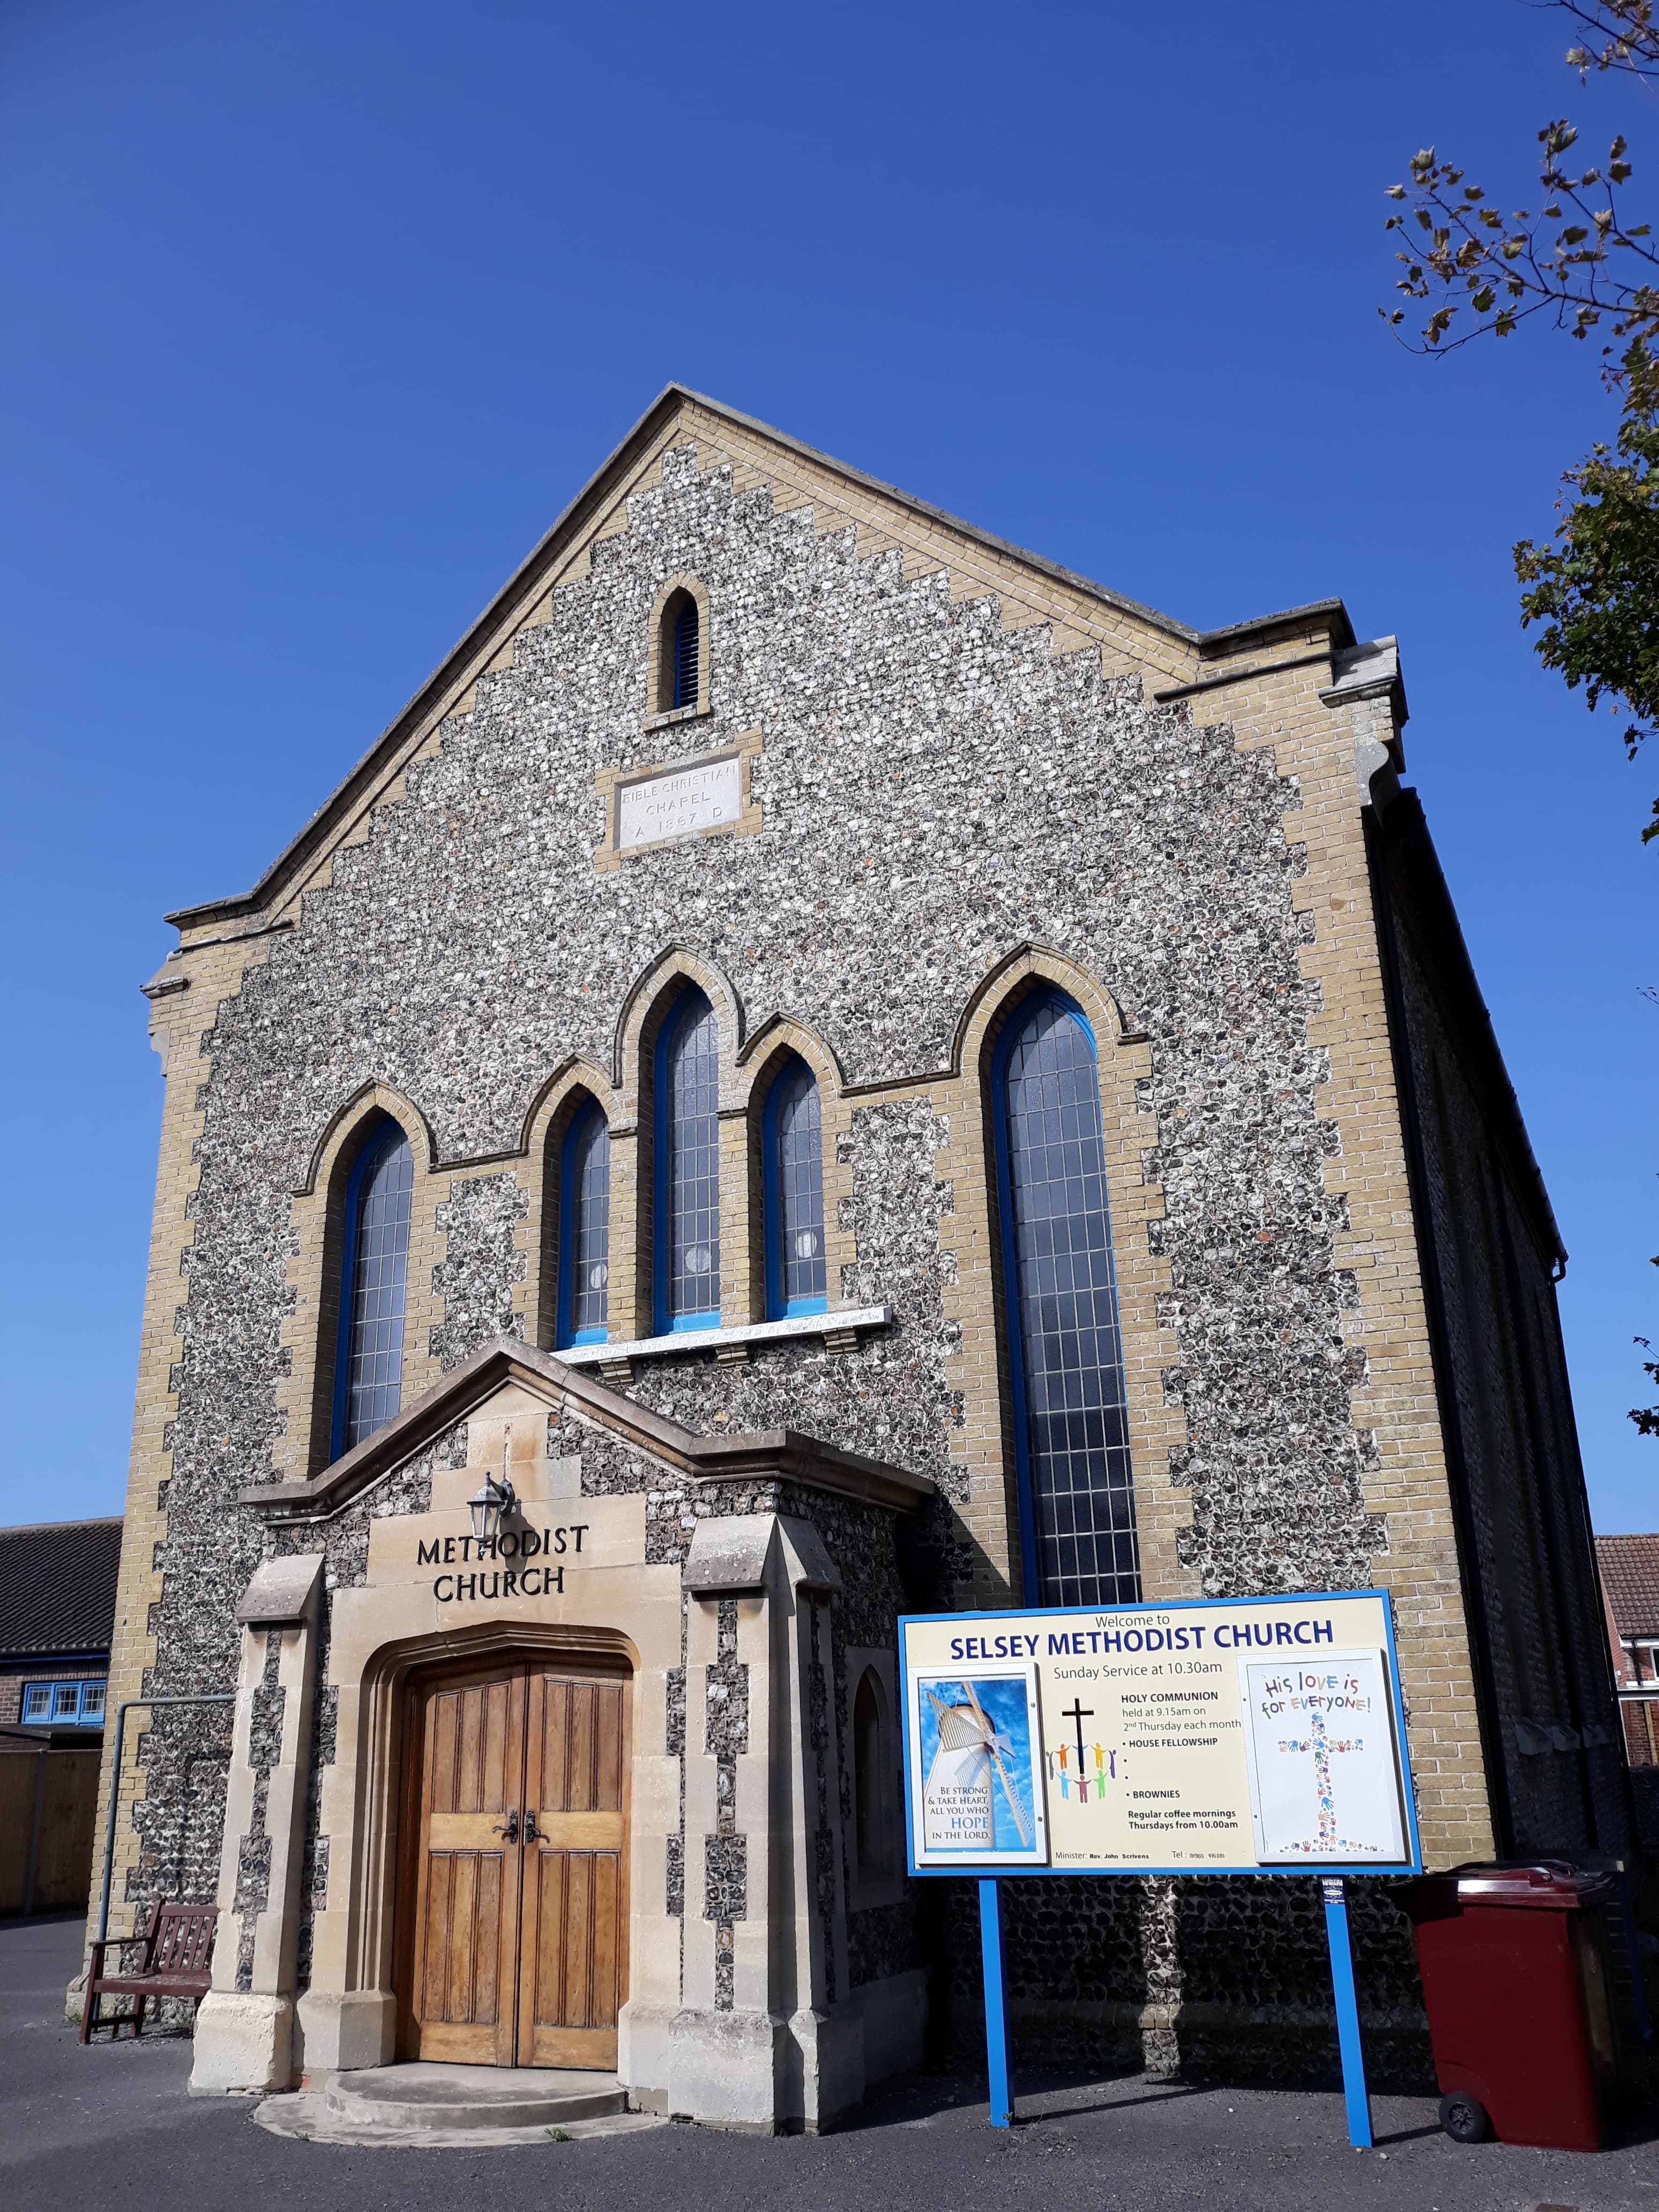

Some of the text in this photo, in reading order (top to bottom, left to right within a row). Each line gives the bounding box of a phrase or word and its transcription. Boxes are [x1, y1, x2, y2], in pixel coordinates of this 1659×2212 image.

[622, 765, 736, 804] BIBLE CHRISTIAN
[646, 791, 711, 815] CHAPEL
[635, 807, 723, 838] A 1867 D
[416, 1525, 589, 1565] METHODIST
[434, 1566, 565, 1602] CHURCH
[1095, 1615, 1170, 1628] Welcome to
[951, 1620, 1334, 1660] SELSEY METHODIST CHURCH
[1054, 1662, 1222, 1680] Sunday Service at 10.30am
[1344, 1673, 1358, 1694] is
[1121, 1691, 1219, 1703] HOLY COMMUNION
[1123, 1708, 1142, 1717] held
[1145, 1709, 1154, 1717] at
[1156, 1707, 1191, 1716] 9.15am
[1261, 1701, 1286, 1719] for
[1124, 1719, 1242, 1732] 2nd Thursday each month
[1129, 1738, 1218, 1747] HOUSE FELLOWSHIP
[940, 1787, 988, 1795] BE STRONG
[1133, 1790, 1180, 1799] BROWNIES
[928, 1797, 989, 1805] & TAKE HEART,
[966, 1806, 989, 1814] WHO
[1128, 1809, 1236, 1820] Regular coffee mornings
[951, 1817, 988, 1829] HOPE
[1129, 1821, 1174, 1830] Thursdays
[1176, 1821, 1197, 1829] from
[932, 1832, 941, 1840] IN
[964, 1830, 990, 1839] LORD.
[1055, 1851, 1087, 1859] Minister:
